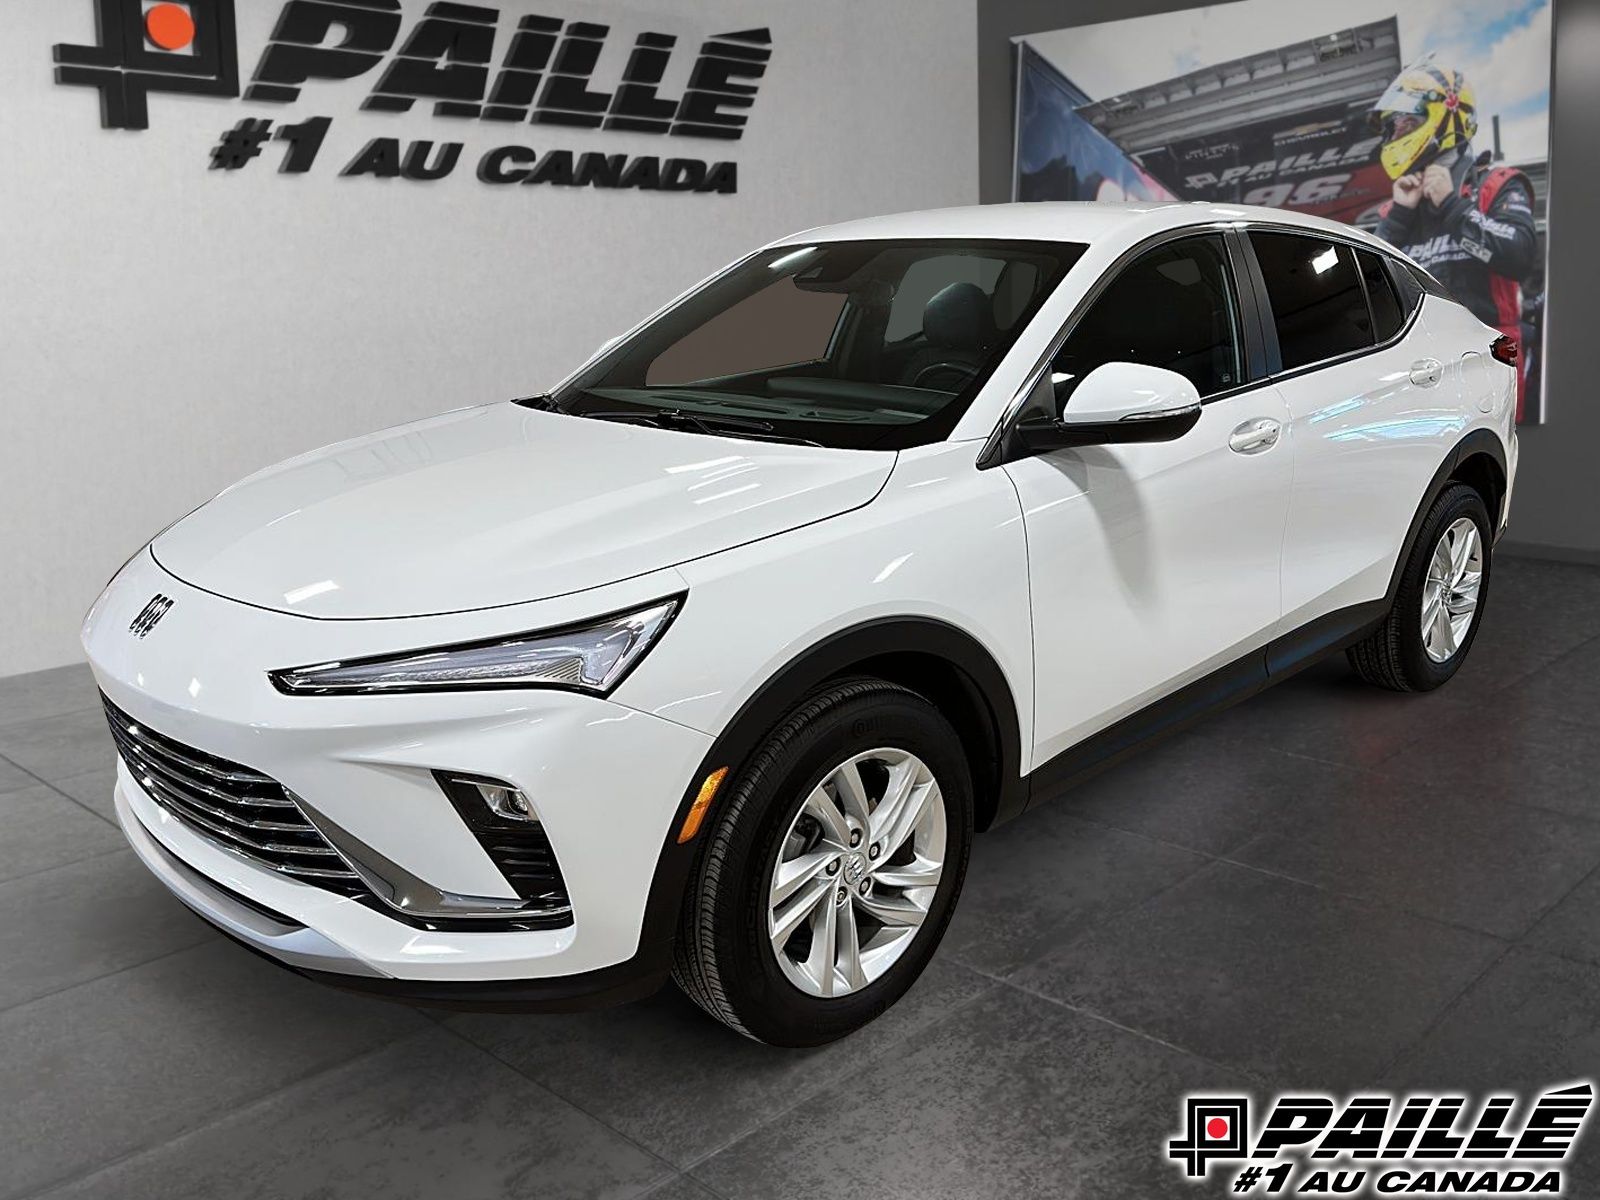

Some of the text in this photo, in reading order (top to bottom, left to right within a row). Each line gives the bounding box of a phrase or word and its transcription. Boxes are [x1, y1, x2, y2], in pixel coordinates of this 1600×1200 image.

[241, 0, 772, 140] PAILLÉ
[208, 116, 737, 194] #1 AU CANADA
